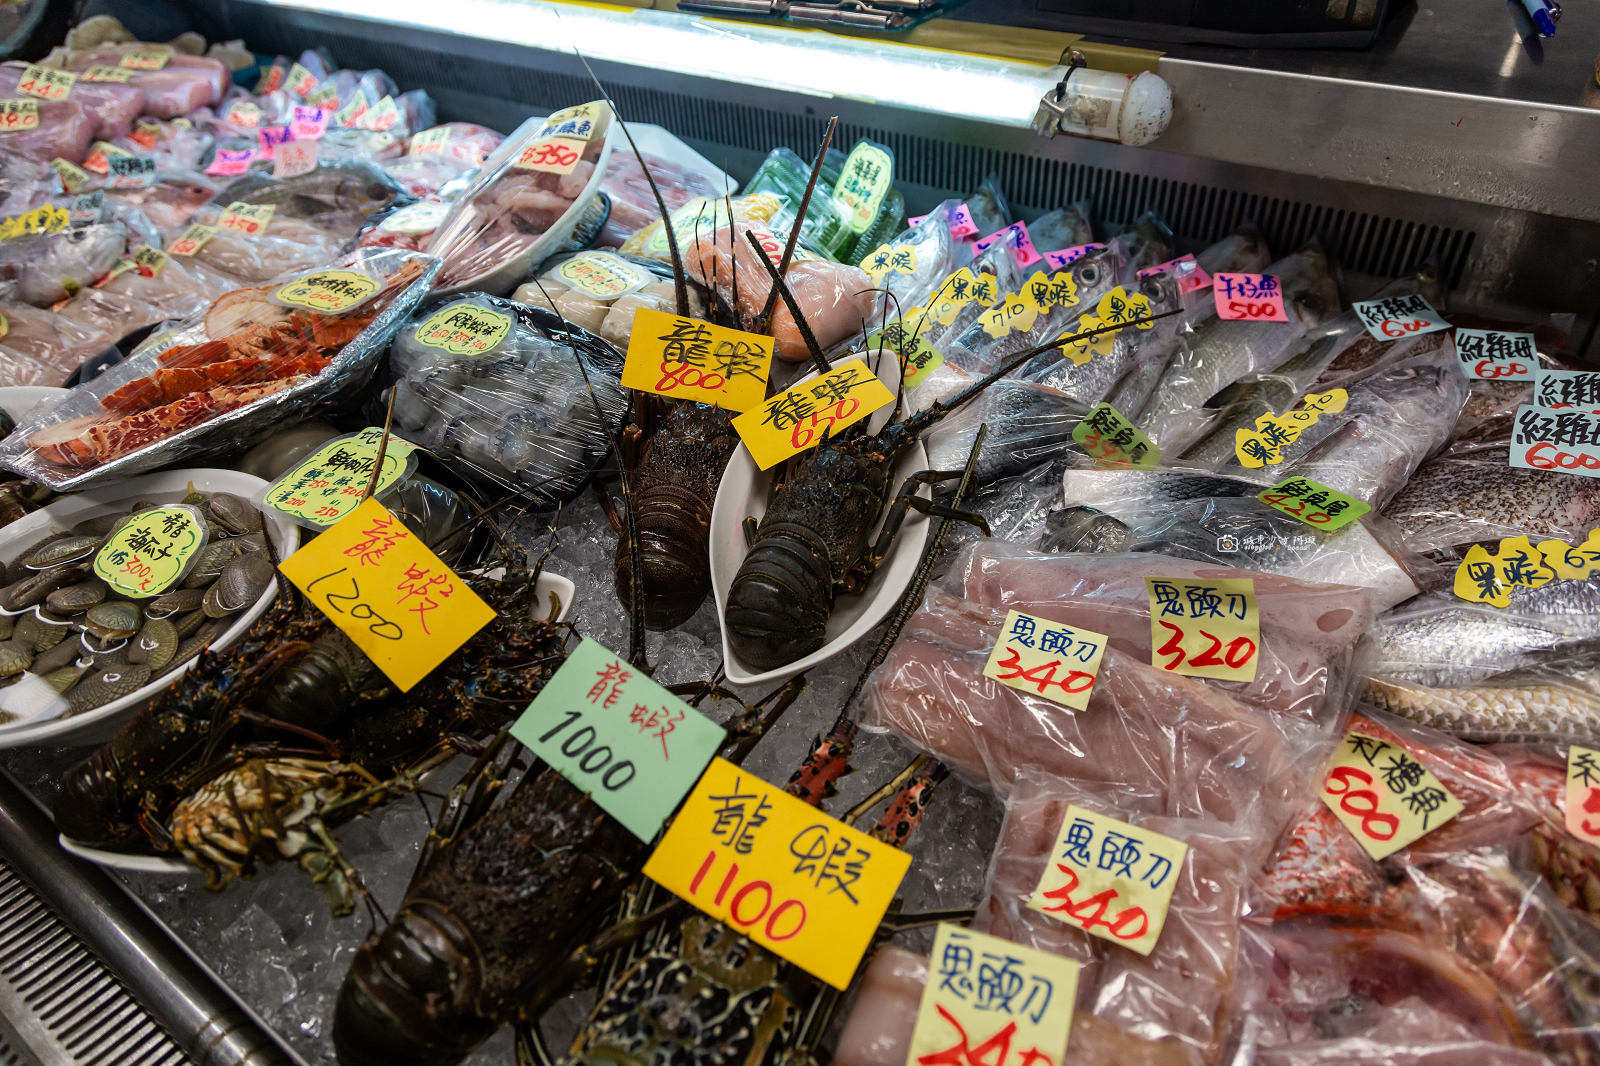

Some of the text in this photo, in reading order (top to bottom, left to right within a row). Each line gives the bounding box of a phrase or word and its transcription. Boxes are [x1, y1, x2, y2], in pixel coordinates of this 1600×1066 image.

[992, 303, 1024, 326] 710
[1228, 301, 1277, 319] 500
[1380, 319, 1432, 338] 600
[658, 320, 767, 384] 龍蝦
[1474, 360, 1528, 379] 600
[761, 368, 879, 430] 龍蝦
[790, 398, 860, 449] 650
[1293, 395, 1333, 421] 690
[1525, 442, 1600, 470] 600
[124, 527, 174, 561] 海瓜子
[343, 514, 454, 636] 龍蝦
[1151, 580, 1247, 620] 鬼頭刀
[307, 567, 403, 640] 1200
[1007, 615, 1098, 663] 鬼頭刀
[1156, 620, 1256, 670] 320
[996, 646, 1095, 694] 340
[586, 659, 686, 761] 龍蝦
[538, 711, 636, 792] 1000
[1323, 766, 1399, 841] 500
[709, 777, 872, 906] 龍蝦
[1062, 818, 1173, 889] 鬼頭刀
[689, 850, 808, 943] 1100
[1041, 863, 1149, 941] 340
[939, 933, 1053, 1025] 鬼頭刀
